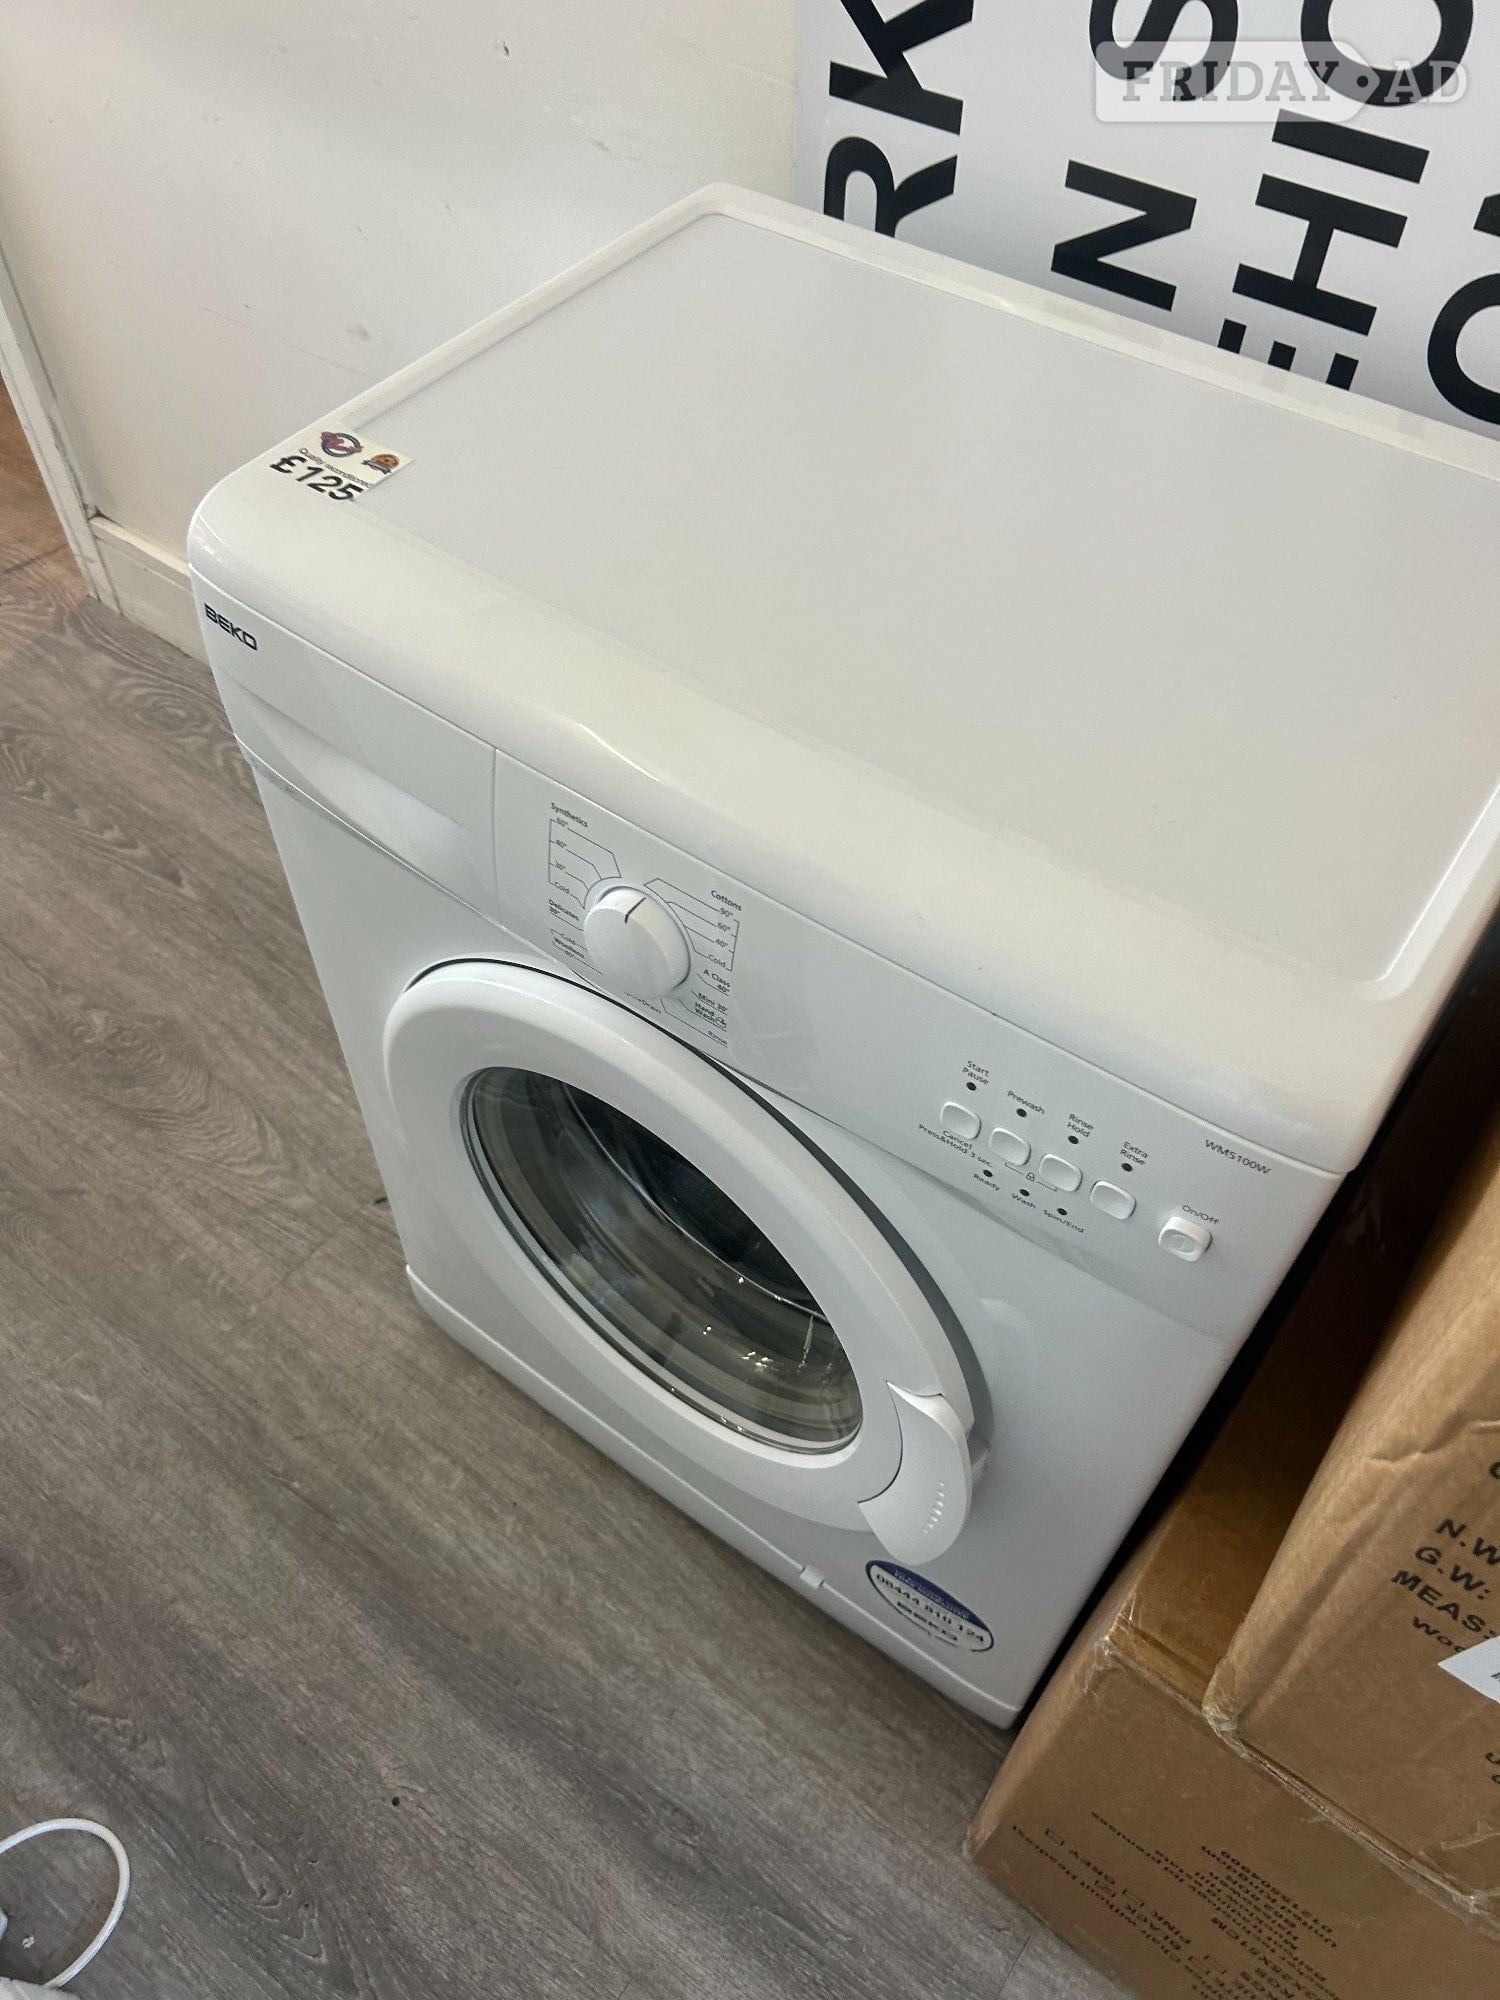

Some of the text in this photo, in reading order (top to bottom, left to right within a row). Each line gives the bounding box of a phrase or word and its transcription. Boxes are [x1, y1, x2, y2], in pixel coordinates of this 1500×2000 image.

[269, 455, 364, 501] £125
[204, 602, 258, 651] BEKO
[550, 802, 587, 828] Synthetics
[711, 889, 742, 911] Cottons
[962, 1067, 989, 1085] Pause
[967, 1060, 990, 1076] Start
[1007, 1090, 1045, 1114] Prewash
[1067, 1122, 1090, 1138] Hold
[1069, 1113, 1094, 1130] Rinse
[942, 1130, 973, 1150] Cancel
[1122, 1141, 1148, 1159] Extra
[1120, 1149, 1146, 1167] Rinse
[973, 1173, 1001, 1191] Ready
[1011, 1193, 1036, 1209] Wash
[1182, 1205, 1221, 1225] On/Off
[1200, 1844, 1336, 1948] United Kingdom
[1124, 1903, 1183, 1951] BLACK
[1151, 1911, 1191, 1945] PINK
